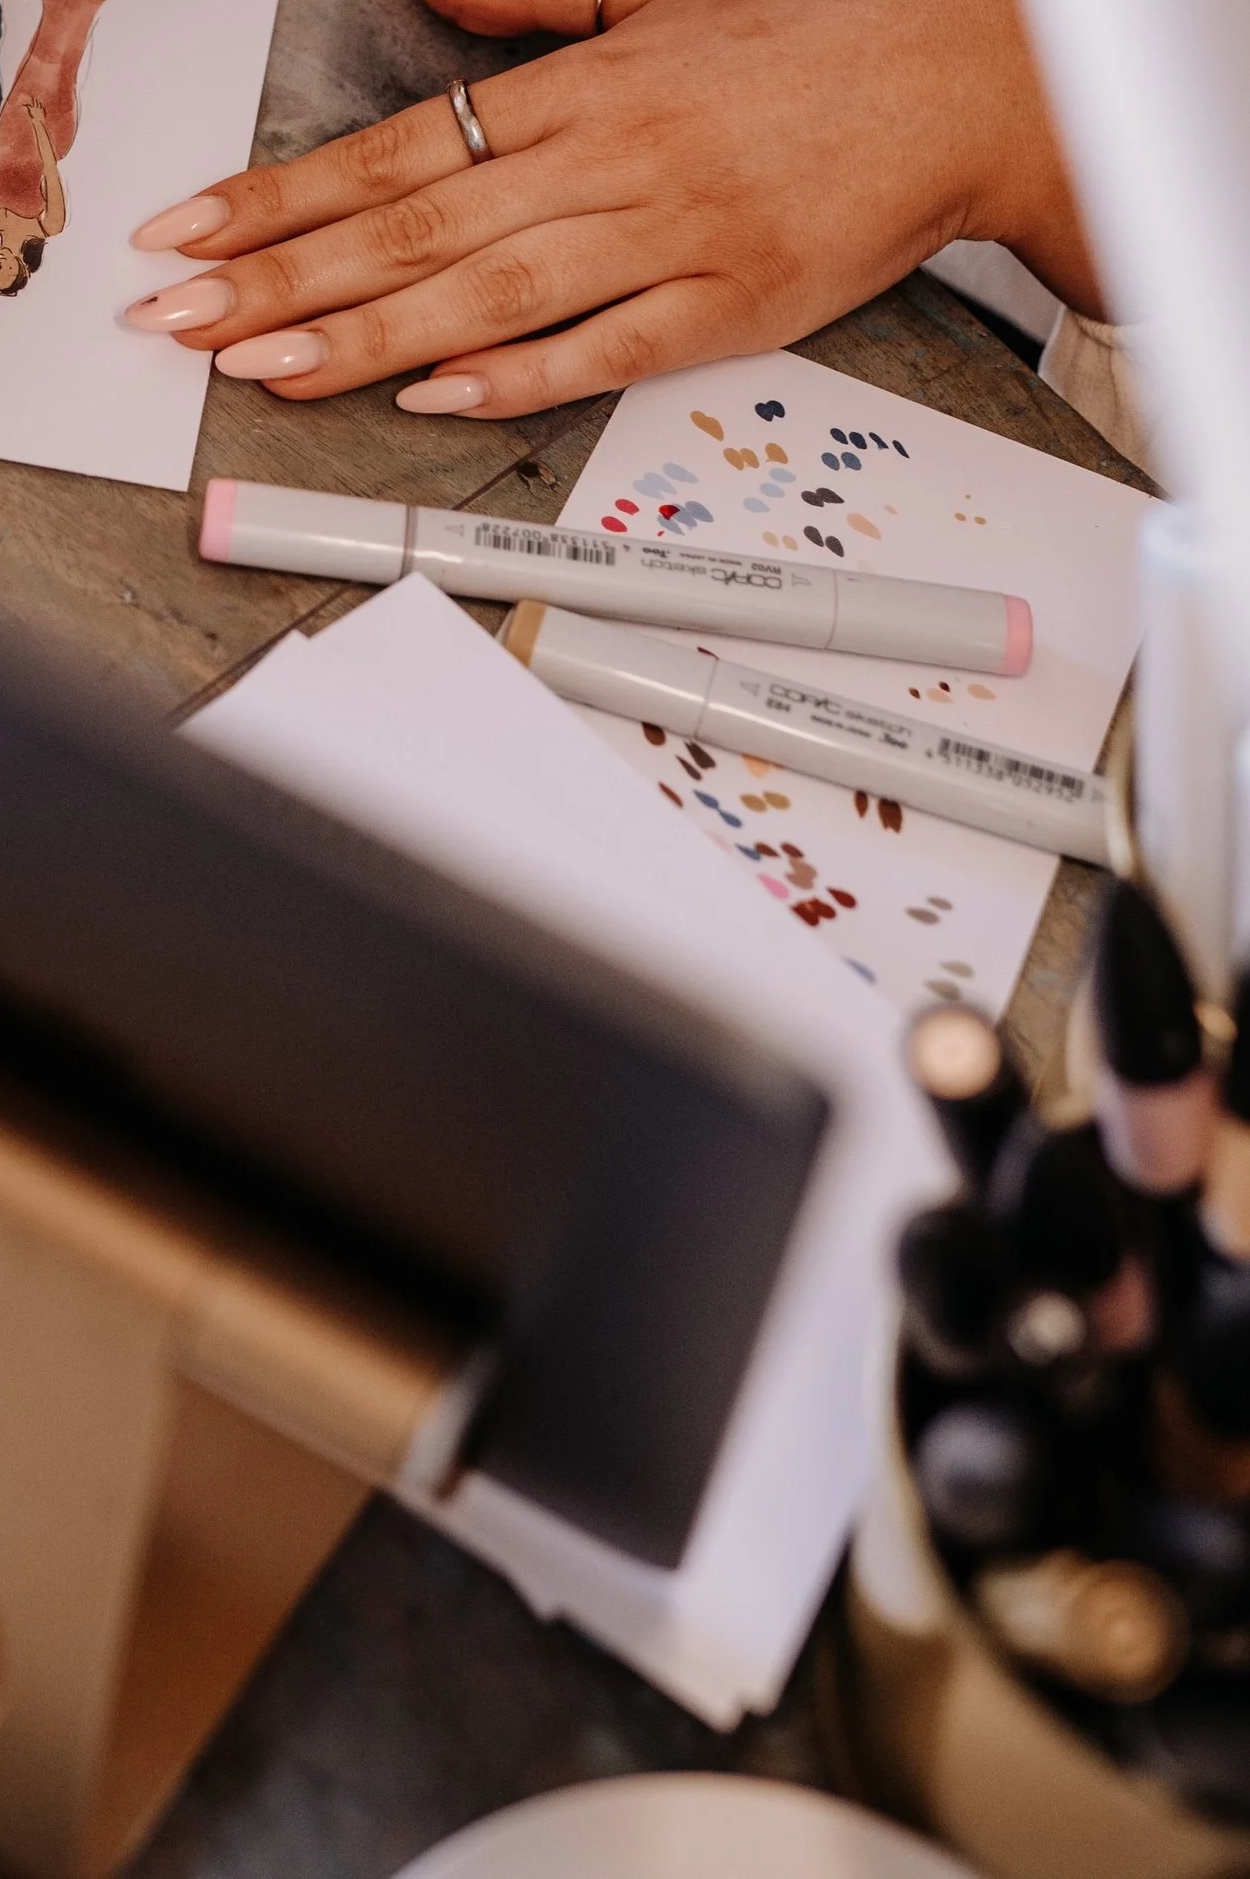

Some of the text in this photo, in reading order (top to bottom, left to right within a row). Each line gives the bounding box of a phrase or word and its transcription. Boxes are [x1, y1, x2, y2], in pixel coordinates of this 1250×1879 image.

[641, 558, 783, 589] COPIC sketch
[751, 562, 783, 575] RV02
[770, 683, 912, 737] COPIC sketch
